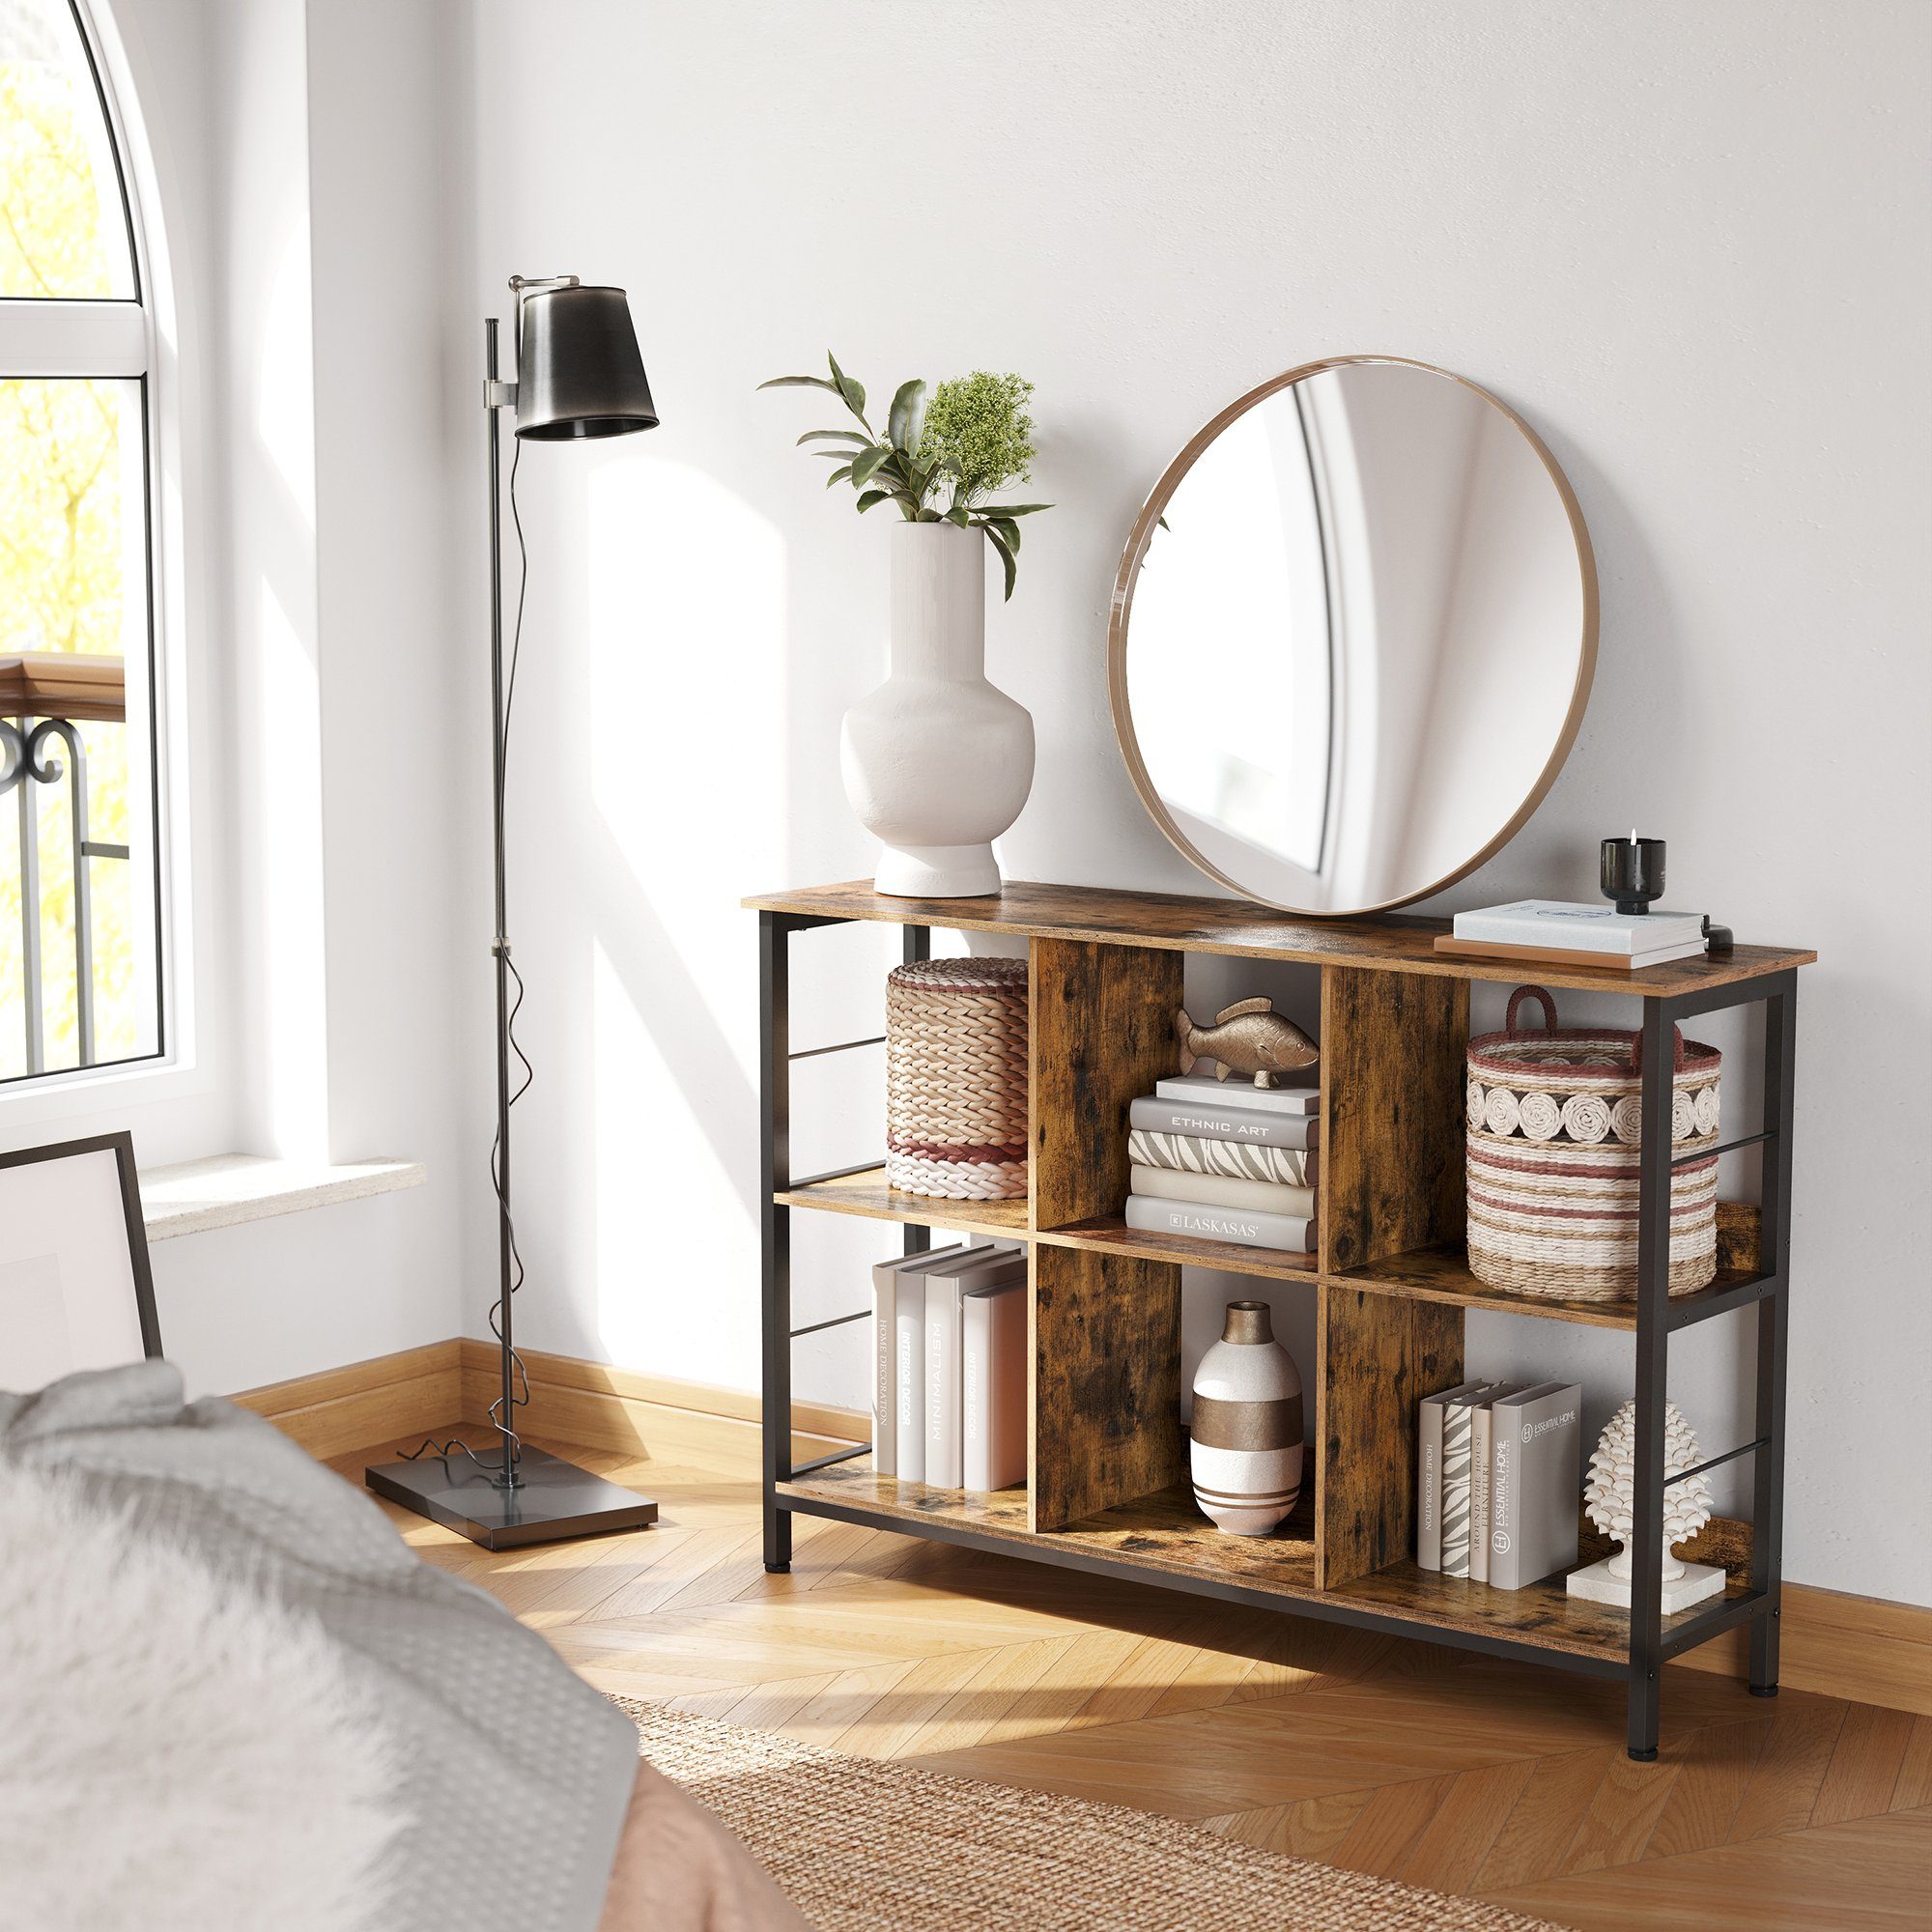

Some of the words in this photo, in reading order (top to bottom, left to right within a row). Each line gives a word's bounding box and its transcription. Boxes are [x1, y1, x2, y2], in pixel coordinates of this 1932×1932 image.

[1172, 1117, 1231, 1131] ETHNIC
[1237, 1125, 1269, 1136] ART
[1184, 1216, 1257, 1237] LASKASAS
[901, 1332, 911, 1386] INTERIOR
[933, 1322, 942, 1440] MINIMALISM
[902, 1388, 911, 1426] DECOR
[1496, 1439, 1506, 1473] HOME
[1495, 1476, 1506, 1526] ESSENTIAL
